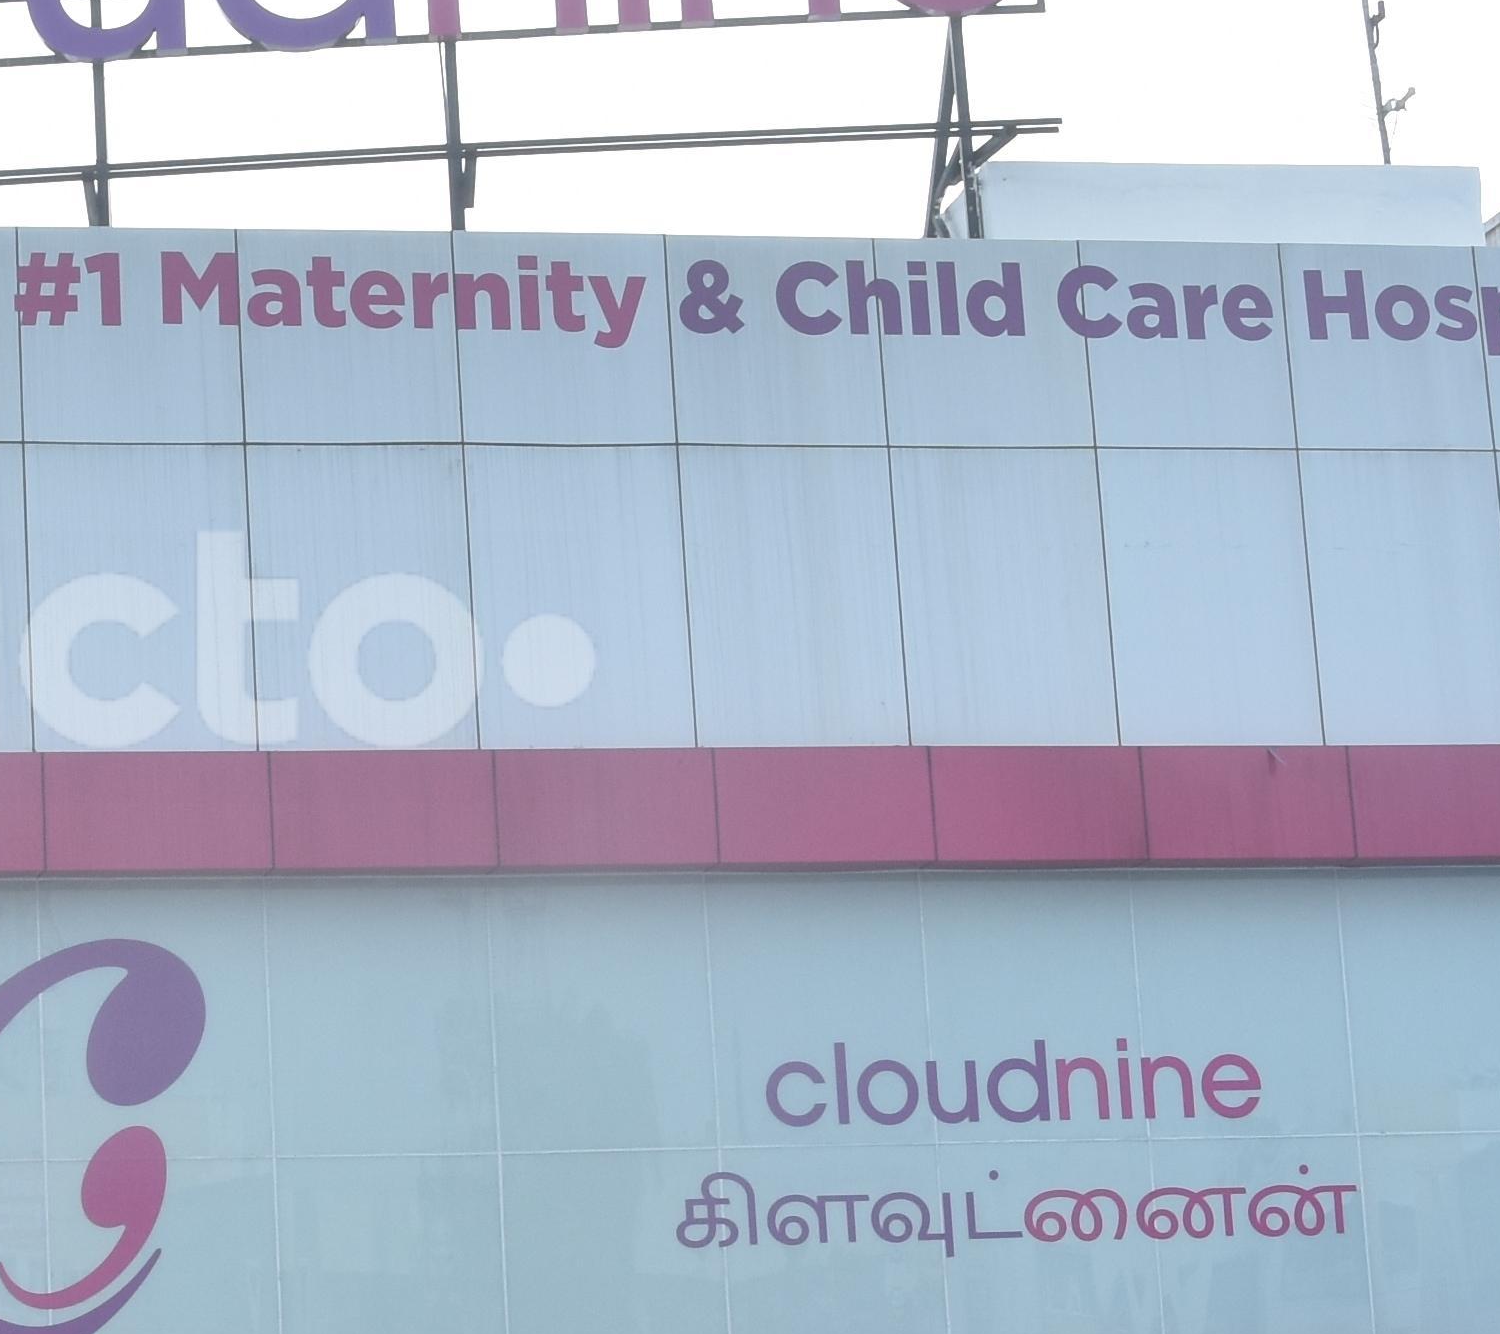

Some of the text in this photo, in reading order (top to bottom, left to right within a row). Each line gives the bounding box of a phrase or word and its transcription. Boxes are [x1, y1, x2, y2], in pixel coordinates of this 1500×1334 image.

[14, 252, 122, 327] #1
[162, 252, 646, 350] Maternity
[678, 259, 745, 336] &
[775, 260, 1027, 339] Child
[1056, 264, 1274, 342] Care
[766, 1038, 1262, 1127] cloudnine
